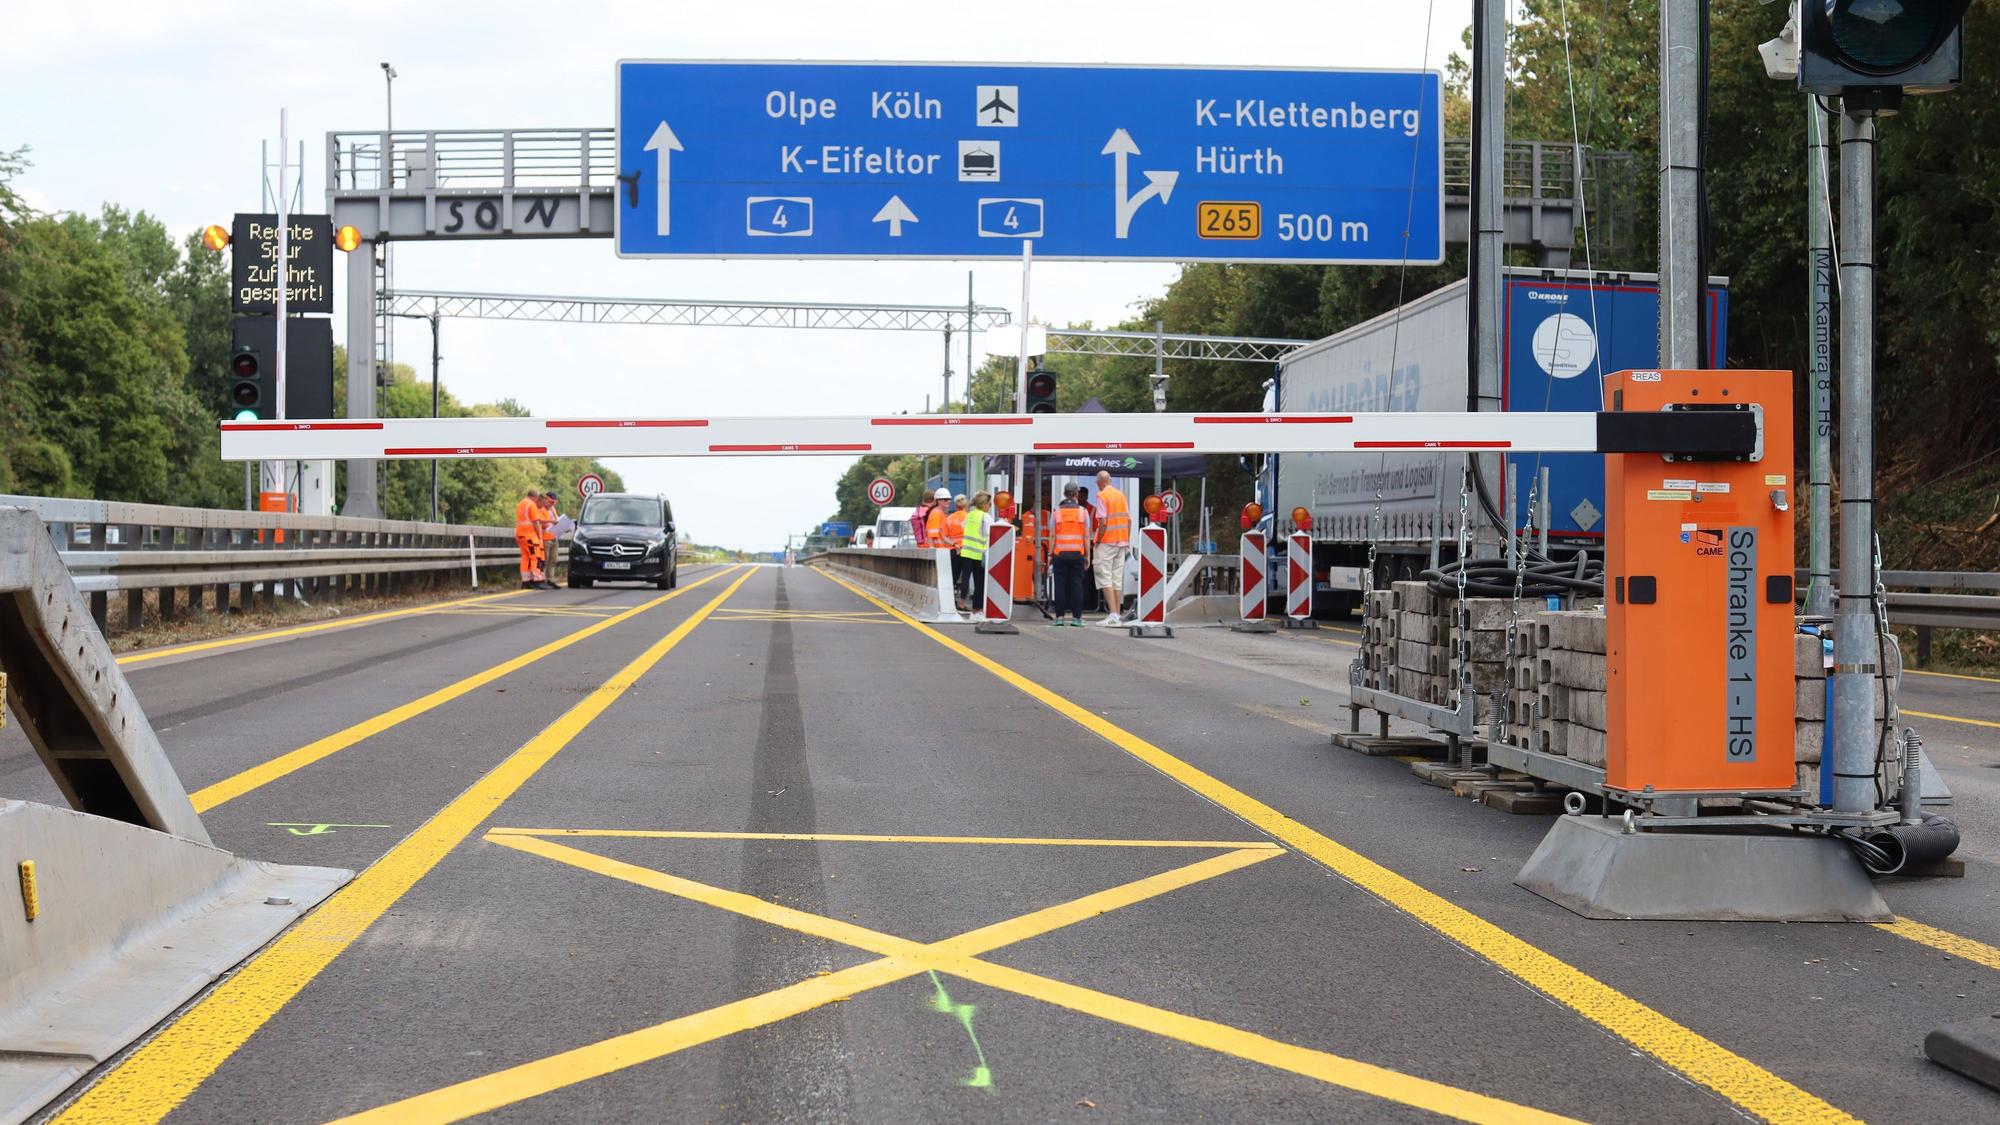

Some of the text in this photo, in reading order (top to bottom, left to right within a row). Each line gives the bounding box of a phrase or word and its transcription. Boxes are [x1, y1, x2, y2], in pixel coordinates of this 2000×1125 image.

[765, 90, 942, 125] Olpe Köln
[1195, 98, 1419, 137] K-Klettenberg
[781, 146, 941, 174] K-Eifeltor
[1195, 146, 1283, 175] Hürth
[772, 205, 788, 228] 4
[1003, 206, 1019, 229] 4
[1207, 209, 1252, 232] 265
[1278, 213, 1369, 242] 500 m
[261, 241, 302, 262] Spur
[247, 264, 316, 283] Zufhrt
[240, 284, 323, 304] gesperrt!
[1538, 293, 1569, 301] KRONE
[1816, 301, 1830, 373] Kamera
[1817, 380, 1830, 390] 8
[1817, 409, 1830, 437] HS
[1065, 456, 1120, 468] traffic-lines
[583, 481, 599, 493] 60
[1405, 460, 1434, 494] Logistik
[873, 486, 889, 498] 60
[1696, 547, 1723, 556] CAME
[1729, 530, 1754, 660] Schranke
[1729, 672, 1753, 682] 1
[1729, 716, 1753, 756] HS
